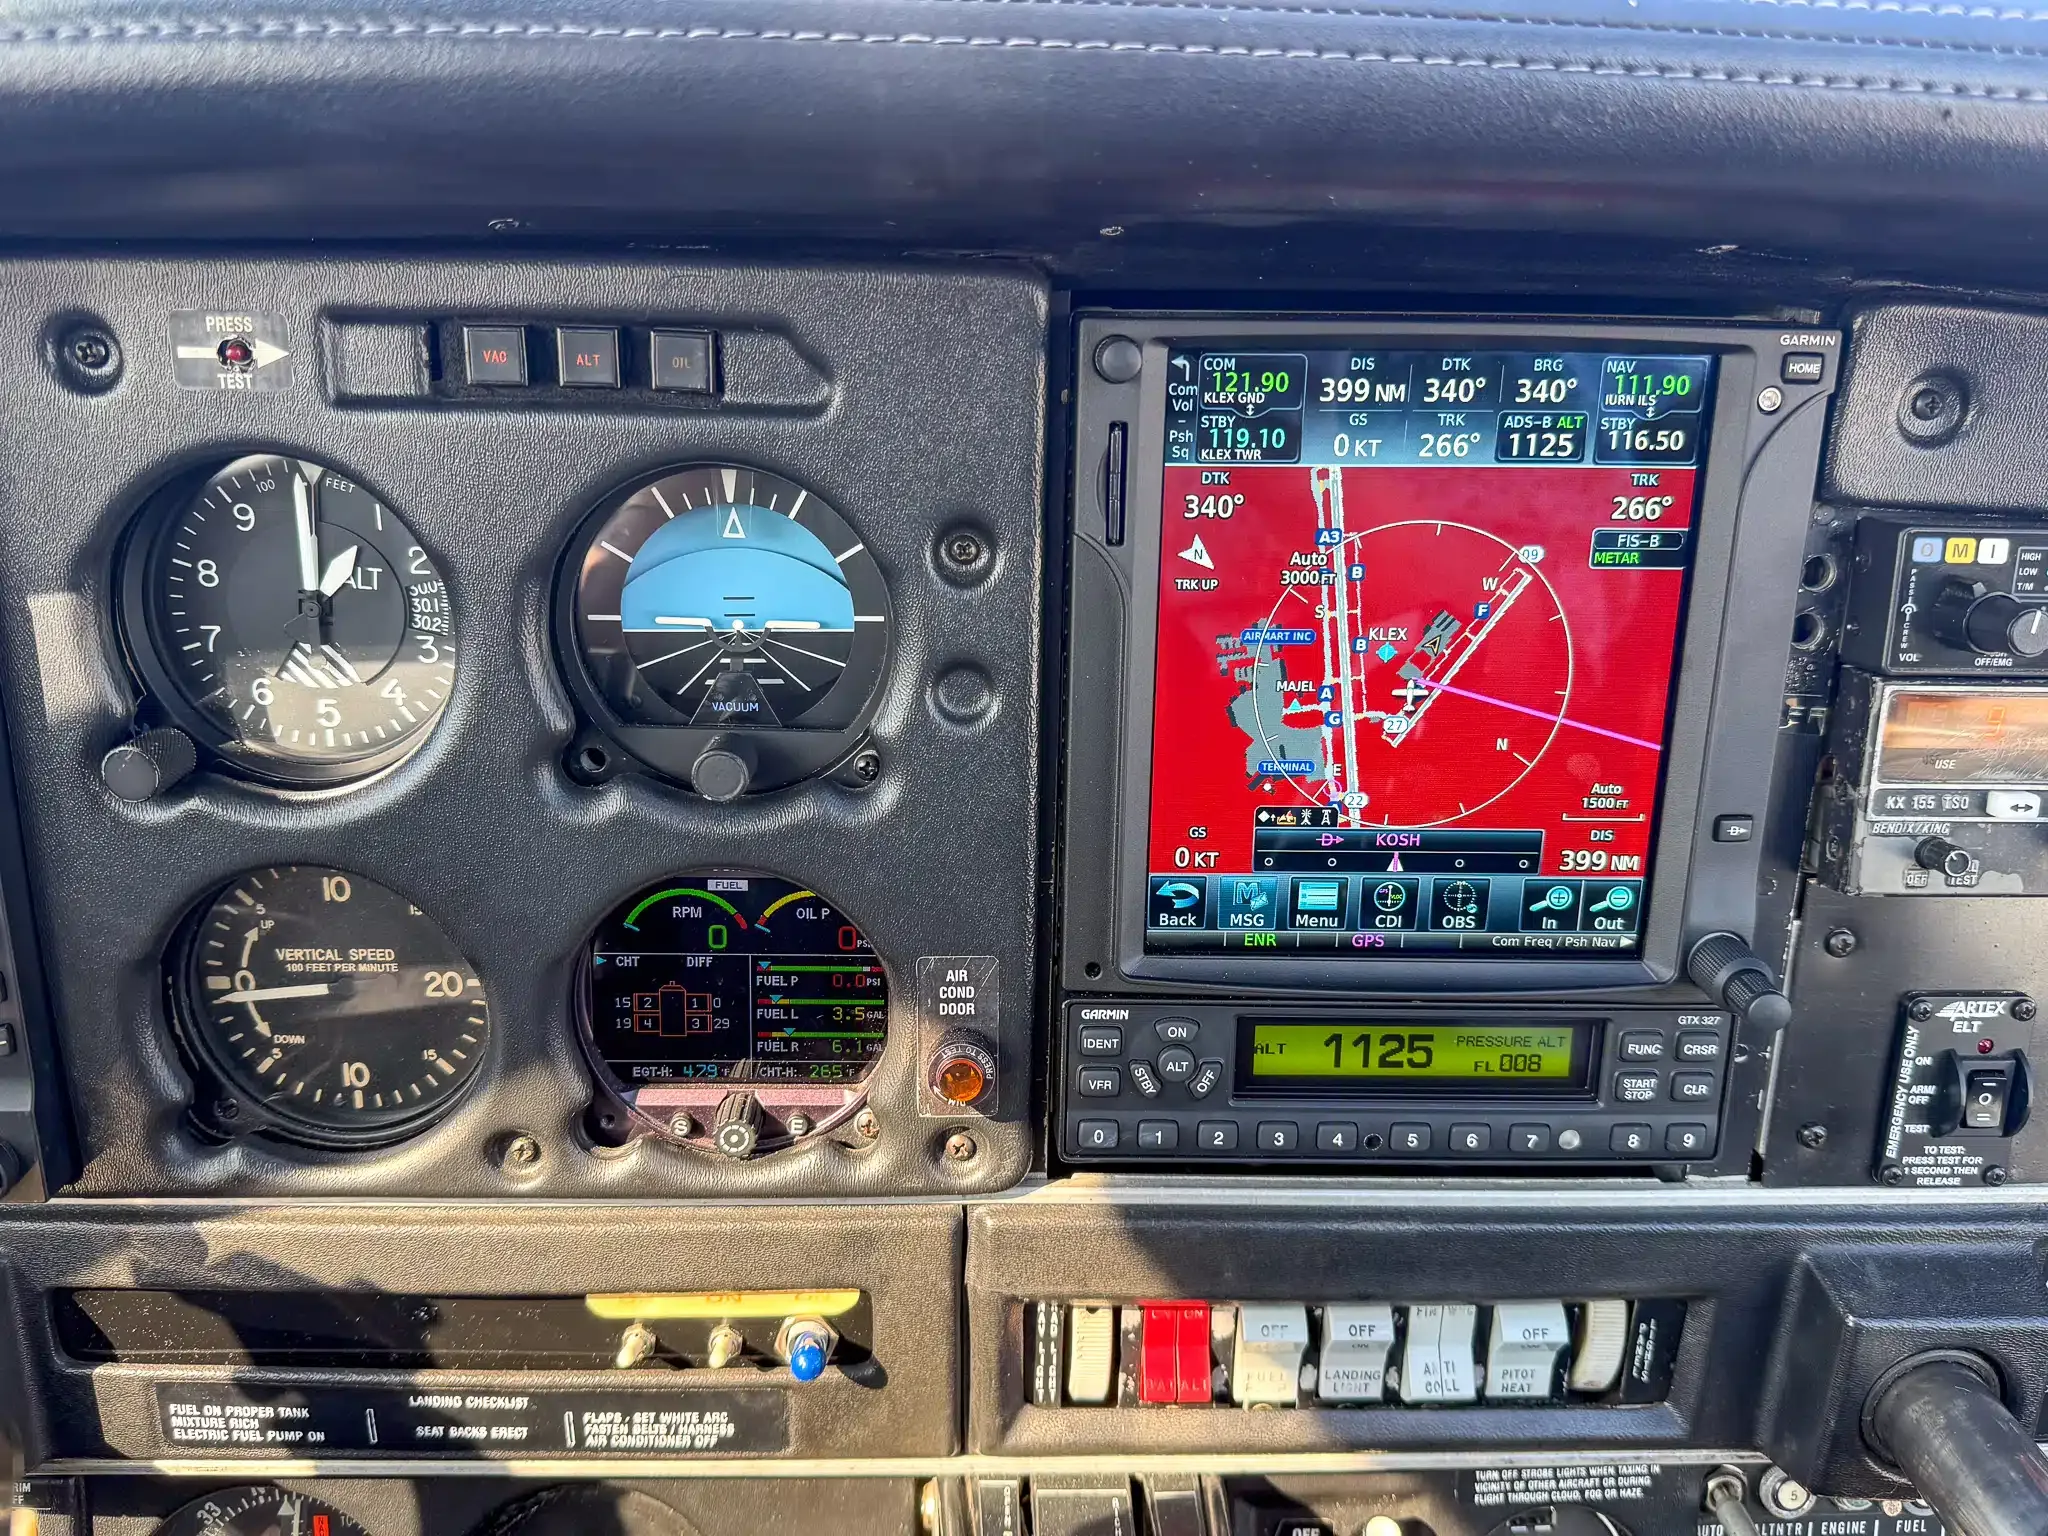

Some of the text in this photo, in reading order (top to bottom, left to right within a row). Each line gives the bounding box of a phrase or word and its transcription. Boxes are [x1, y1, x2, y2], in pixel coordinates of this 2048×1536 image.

[206, 317, 252, 332] PRESS
[1780, 335, 1835, 345] GARMIN
[482, 351, 507, 363] VAC
[576, 354, 600, 367] ALT
[1204, 358, 1236, 371] COM
[1350, 358, 1375, 370] DIS
[1442, 358, 1471, 371] DTK
[1534, 359, 1563, 371] BRG
[1607, 361, 1636, 373] NAV
[1789, 363, 1822, 374] HOME
[218, 374, 252, 389] TEST
[1212, 371, 1289, 393] 121.90
[1615, 375, 1691, 396] 111.90
[1168, 383, 1198, 396] Com
[1319, 378, 1406, 402] 399 NM
[1204, 392, 1265, 404] KLEX GND
[1172, 399, 1193, 412] Vol
[1200, 416, 1236, 428] STBY
[1349, 413, 1368, 426] GS
[1438, 414, 1467, 427] TRK
[1556, 416, 1584, 429] ALT
[1601, 418, 1636, 430] STBY
[1169, 430, 1194, 443] Psh
[1209, 428, 1286, 449] 119.10
[1609, 430, 1685, 451] 116.50
[1355, 440, 1382, 457] KT
[1509, 433, 1574, 457] 1125
[1201, 449, 1262, 460] KLEX TWR
[1201, 471, 1230, 485] DTK
[1631, 474, 1659, 486] TRK
[256, 480, 275, 493] 100
[326, 478, 356, 493] FEET
[232, 503, 255, 532] 9
[408, 546, 430, 575] 2
[1290, 551, 1328, 566] Auto
[1594, 553, 1640, 564] METAR
[2021, 553, 2041, 561] HIGH
[197, 559, 220, 588] 8
[2019, 568, 2038, 576] LOW
[1176, 579, 1219, 590] TRK UP
[200, 626, 221, 652] 7
[1368, 628, 1408, 641] KLEX
[416, 636, 439, 663] 3
[1899, 653, 1919, 662] VOL
[1974, 658, 2013, 667] OFF/EMG
[252, 678, 274, 705] 6
[380, 678, 406, 705] 4
[1276, 681, 1316, 692] MAJEL
[317, 699, 341, 727] 5
[712, 702, 759, 712] VACUUM
[1935, 760, 1956, 769] USE
[1591, 783, 1622, 795] Auto
[1189, 827, 1207, 838] GS
[1872, 823, 1950, 834] BENDIX/KING
[1376, 834, 1420, 846] KOSH
[1590, 830, 1614, 841] DIS
[1194, 852, 1219, 867] KT
[1559, 850, 1639, 871] 399 NM
[323, 876, 351, 902] 10
[672, 906, 702, 918] RPM
[796, 908, 817, 919] OIL
[1159, 914, 1197, 926] Back
[1230, 914, 1264, 926] MSG
[1296, 915, 1338, 927] Menu
[1375, 915, 1402, 927] CDI
[1442, 916, 1475, 928] OBS
[1594, 917, 1624, 930] Out
[1244, 934, 1276, 946] ENR
[1352, 935, 1384, 947] GPS
[1492, 936, 1616, 948] Com Freq Psh Nav
[276, 949, 395, 961] VERTICAL SPEED
[616, 956, 640, 967] CHT
[686, 956, 713, 967] DIFF
[306, 964, 399, 972] FEET PER MINUTE
[756, 976, 787, 986] FUEL
[946, 970, 968, 982] AIR
[424, 972, 463, 997] 20
[939, 986, 975, 999] COND
[756, 1009, 787, 1019] FUEL
[939, 1003, 975, 1015] DOOR
[1081, 1010, 1129, 1020] GARMIN
[1678, 1016, 1720, 1025] GTX 327
[1167, 1027, 1187, 1038] ON
[1953, 1021, 1982, 1033] ELT
[274, 1034, 305, 1044] DOWN
[1083, 1039, 1119, 1048] IDENT
[1456, 1036, 1567, 1047] PRESSURE ALT
[756, 1042, 787, 1052] FUEL
[1324, 1033, 1434, 1069] 1125
[1628, 1044, 1662, 1054] FUNC
[1684, 1045, 1718, 1055] CRSR
[1166, 1062, 1188, 1072] ALT
[342, 1062, 371, 1087] 10
[1088, 1080, 1112, 1090] VFR
[1622, 1079, 1657, 1089] START
[1684, 1085, 1708, 1095] CLR
[1624, 1091, 1655, 1100] STOP
[1904, 1125, 1930, 1133] TEST
[1911, 1167, 1950, 1175] SECOND
[1917, 1177, 1961, 1185] RELEASE
[1349, 1325, 1376, 1337] OFF
[1522, 1328, 1549, 1340] OFF
[1325, 1370, 1381, 1381] LANDING
[1502, 1369, 1536, 1380] PITOT
[409, 1396, 529, 1410] LANDING CHECKLIST
[170, 1404, 310, 1418] FUEL ON PROPER TANK
[171, 1417, 259, 1429] MIXTURE RICH
[659, 1412, 700, 1424] WHITE
[173, 1429, 325, 1442] ELECTRIC FUEL PUMP ON
[416, 1425, 529, 1440] SEAT ERECT
[610, 1435, 692, 1448] CONDITIONER
[1476, 1466, 1616, 1481] TURN OFF STROBE LIGHTS WHEN
[1475, 1476, 1652, 1493] VICINITY OTHER AIRCRAFT DURING
[1474, 1492, 1549, 1505] FLIGHT THROUGH
[1821, 1520, 1867, 1535] ENGINE
[1896, 1519, 1927, 1533] FUEL
